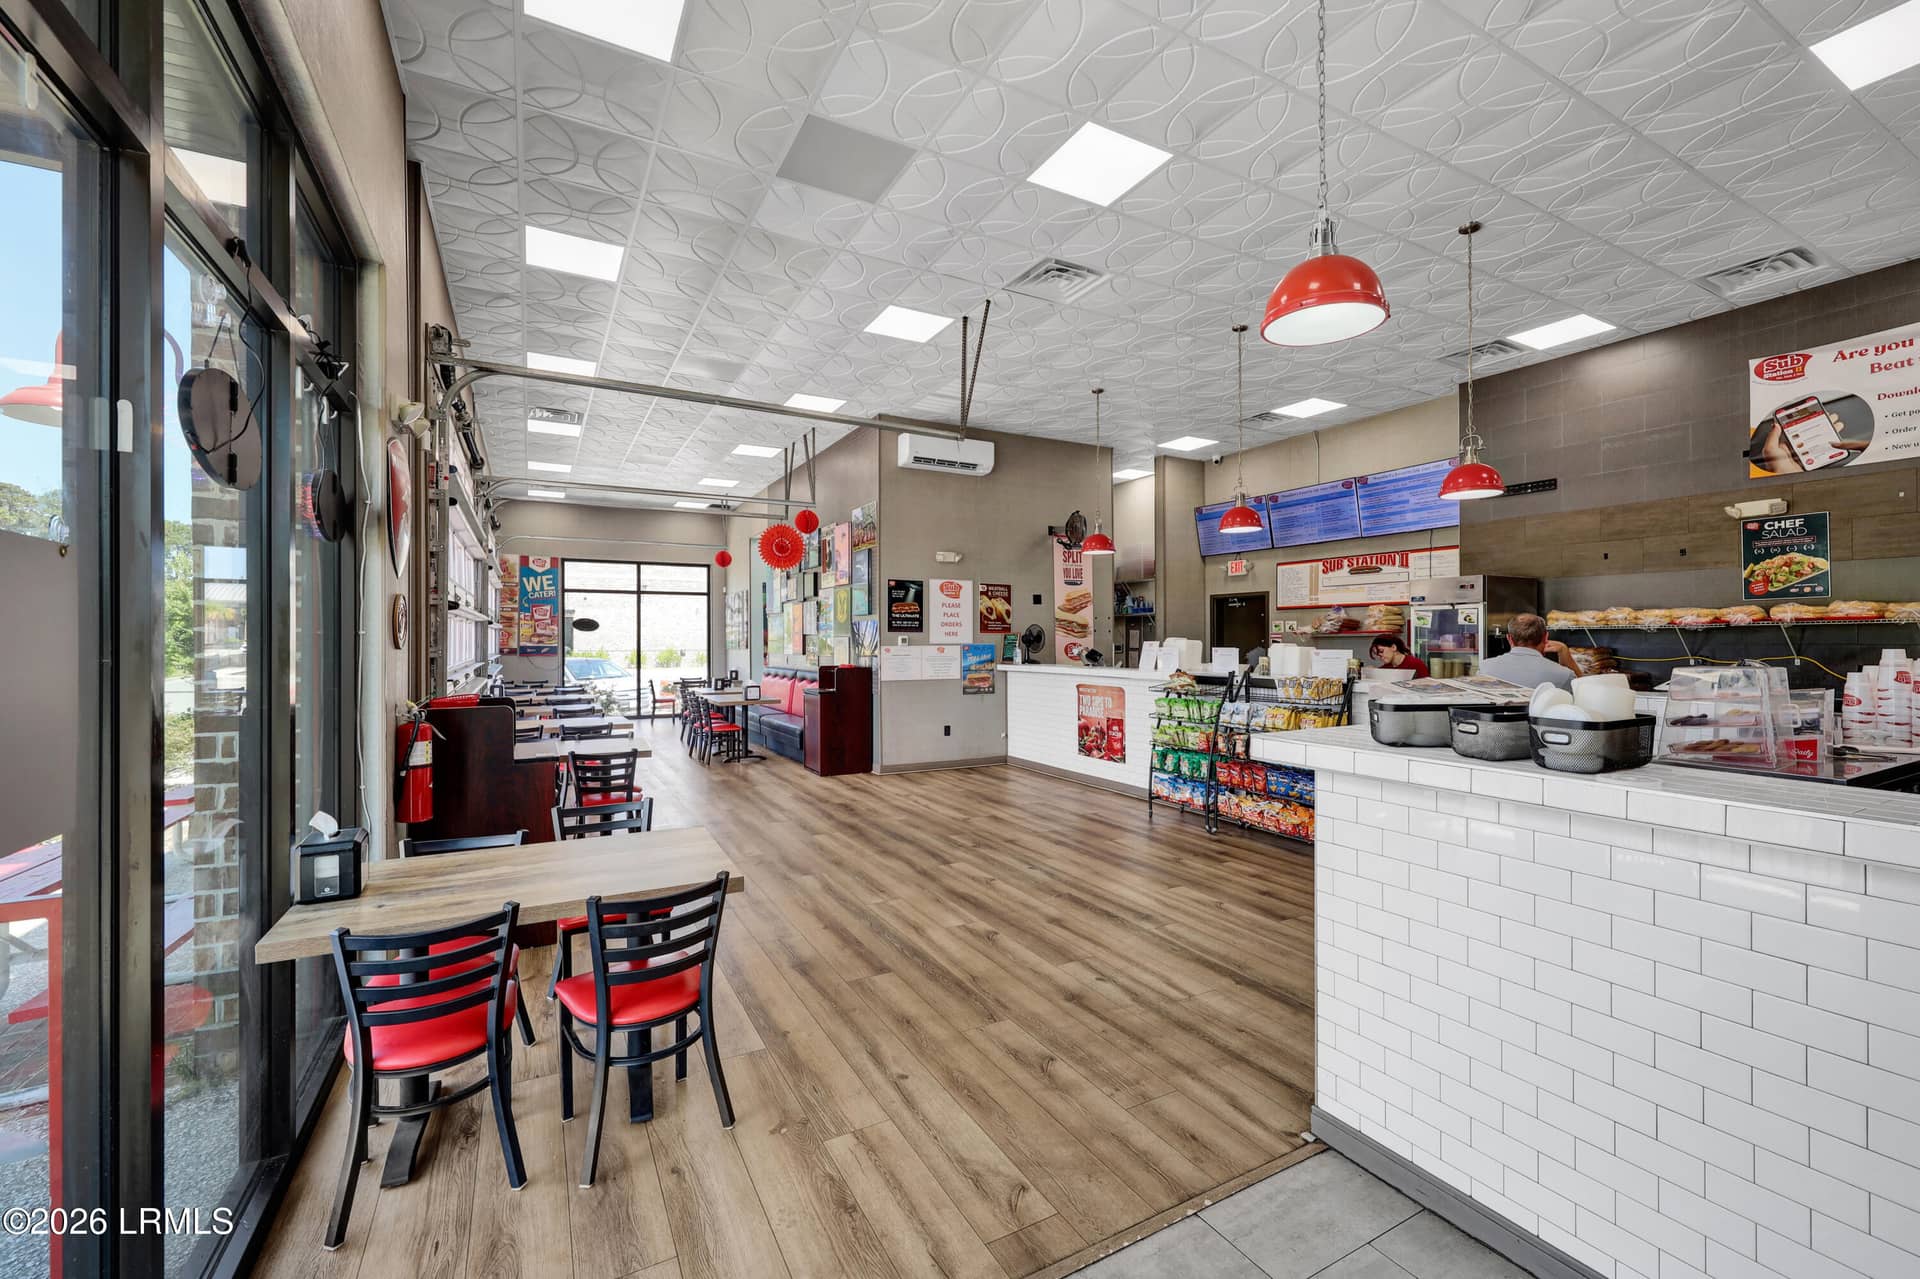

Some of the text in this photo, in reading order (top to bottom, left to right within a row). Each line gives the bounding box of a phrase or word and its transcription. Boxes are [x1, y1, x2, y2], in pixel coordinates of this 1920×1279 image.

[1833, 338, 1914, 362] Are you
[1763, 355, 1803, 373] Sub
[1870, 357, 1914, 374] Beat
[1891, 410, 1906, 418] Get
[1891, 426, 1917, 434] Order
[1891, 443, 1911, 451] New
[1764, 518, 1805, 530] CHEF
[1762, 527, 1808, 539] SALAD
[1062, 550, 1082, 563] SPLIT
[1322, 552, 1409, 574] SUB STATION II
[1230, 560, 1244, 574] EXIT
[522, 575, 555, 592] WE
